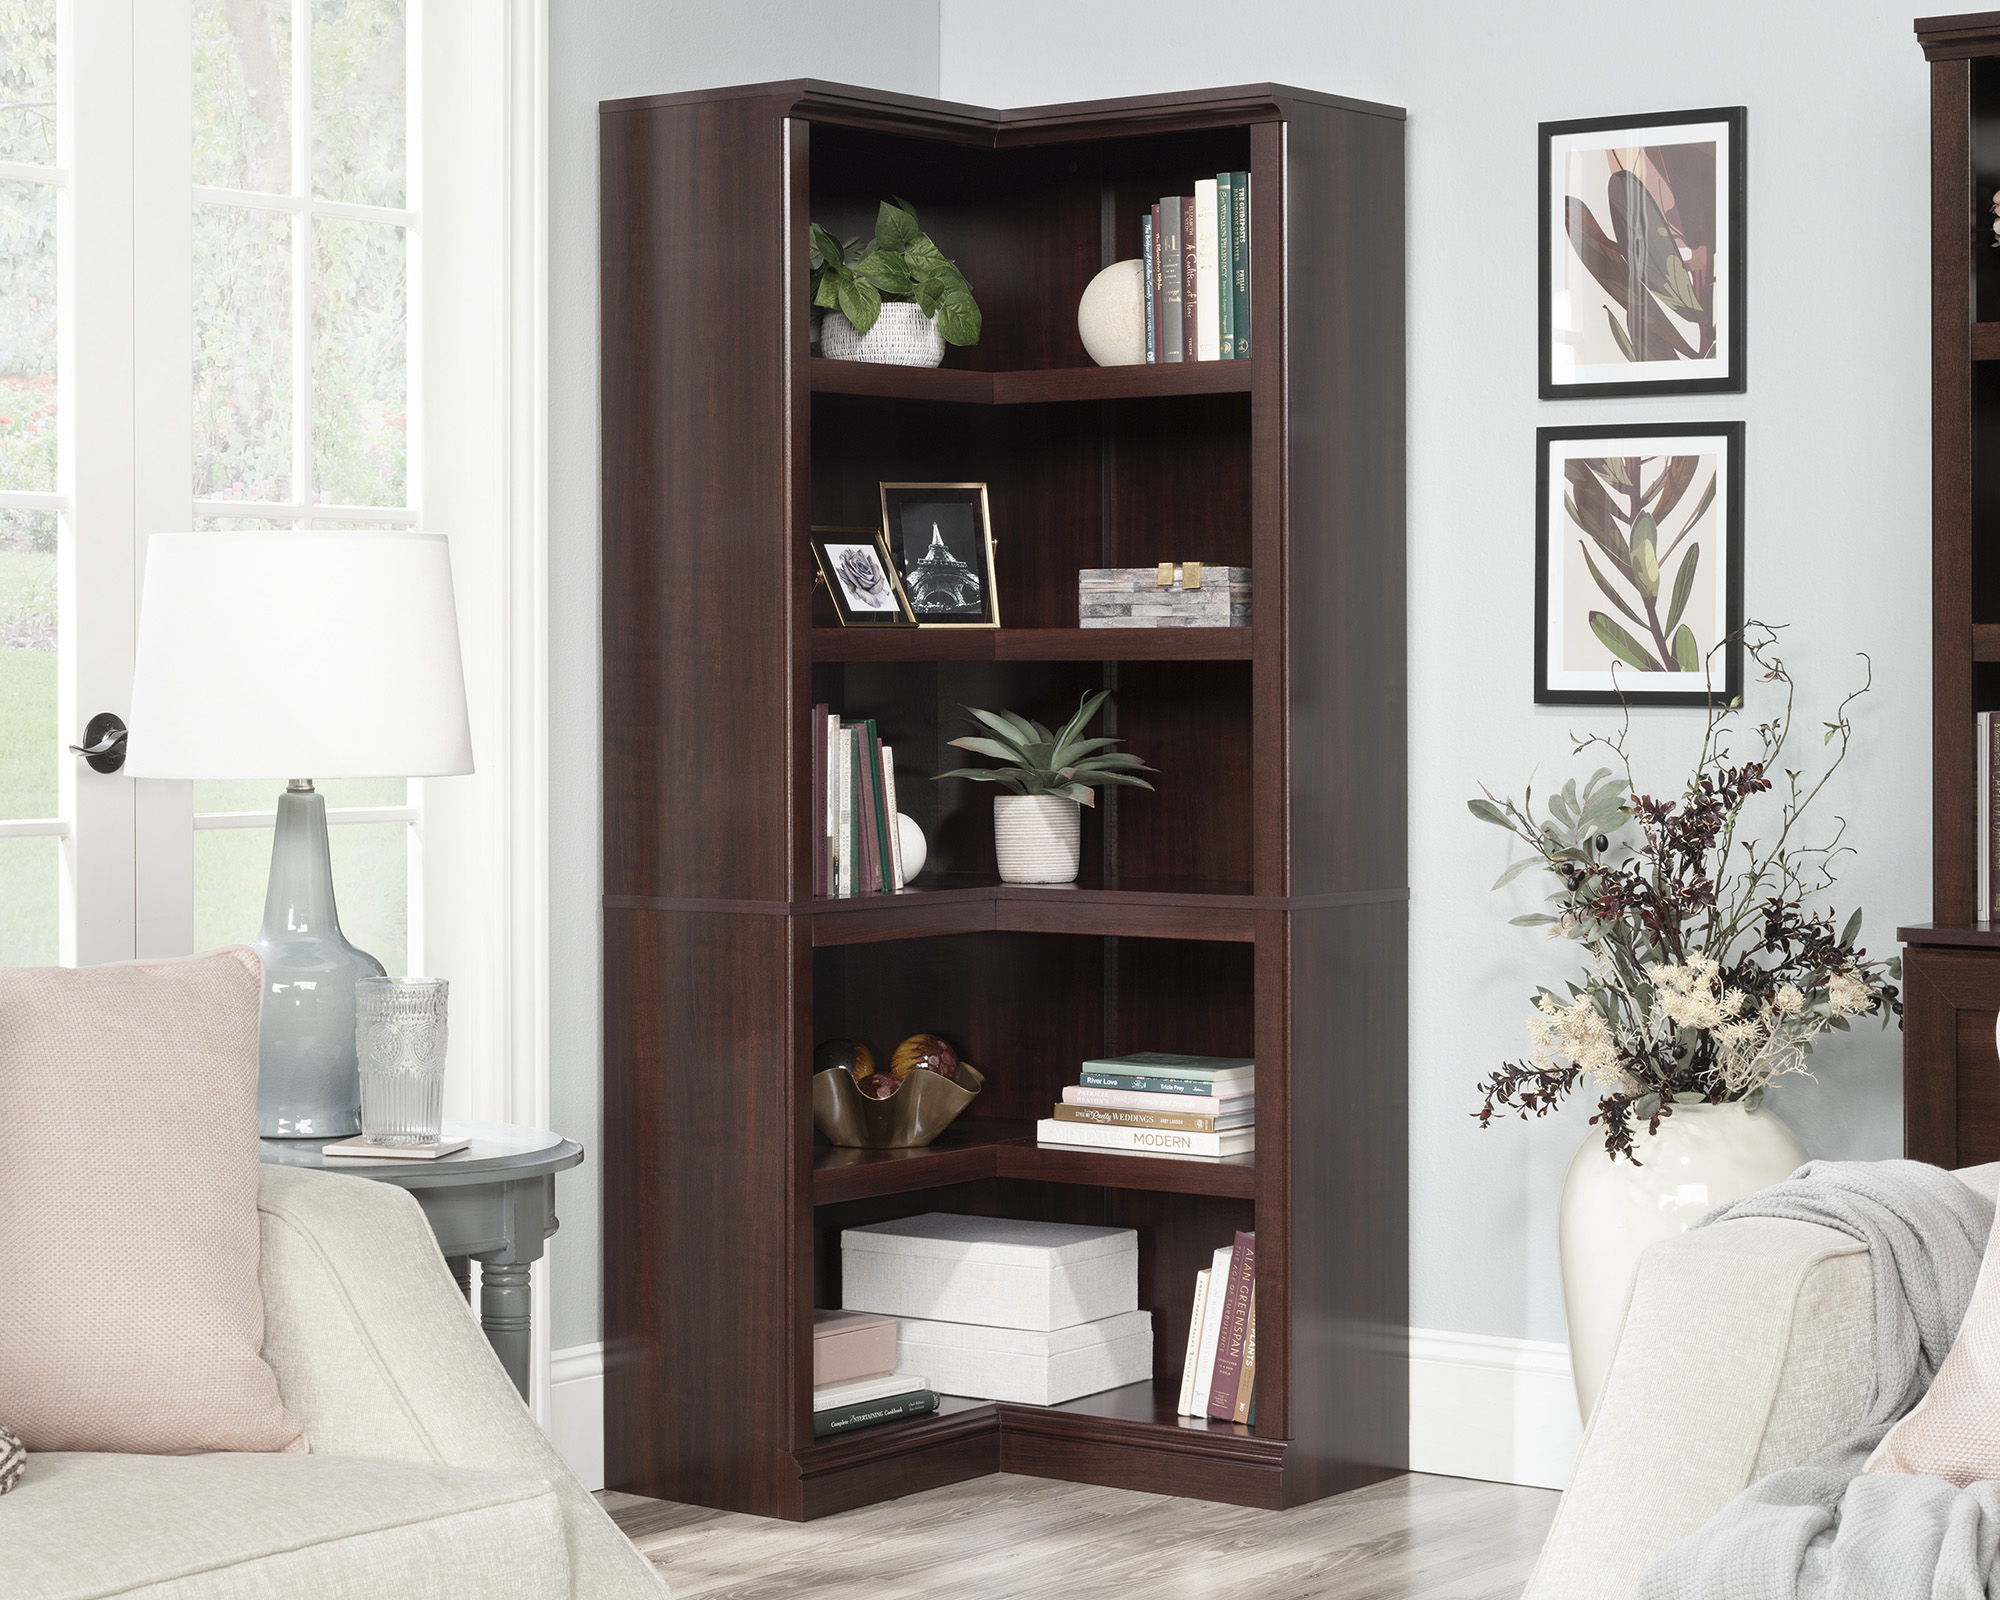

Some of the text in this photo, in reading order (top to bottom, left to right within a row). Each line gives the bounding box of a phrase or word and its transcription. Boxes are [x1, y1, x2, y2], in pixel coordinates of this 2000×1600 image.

[1185, 253, 1196, 287] Coalition
[1186, 290, 1196, 298] of
[1086, 1076, 1102, 1084] River
[1089, 1110, 1112, 1123] Pretty
[1112, 1112, 1154, 1122] WEDDINGS
[1133, 1132, 1190, 1148] MODERN
[1242, 1248, 1254, 1282] ALAN
[1229, 1284, 1235, 1295] OF
[1220, 1300, 1232, 1352] TURBULENCE
[1230, 1285, 1248, 1357] GREENSPAN
[830, 1418, 848, 1428] Complete
[884, 1406, 902, 1416] Cookbook
